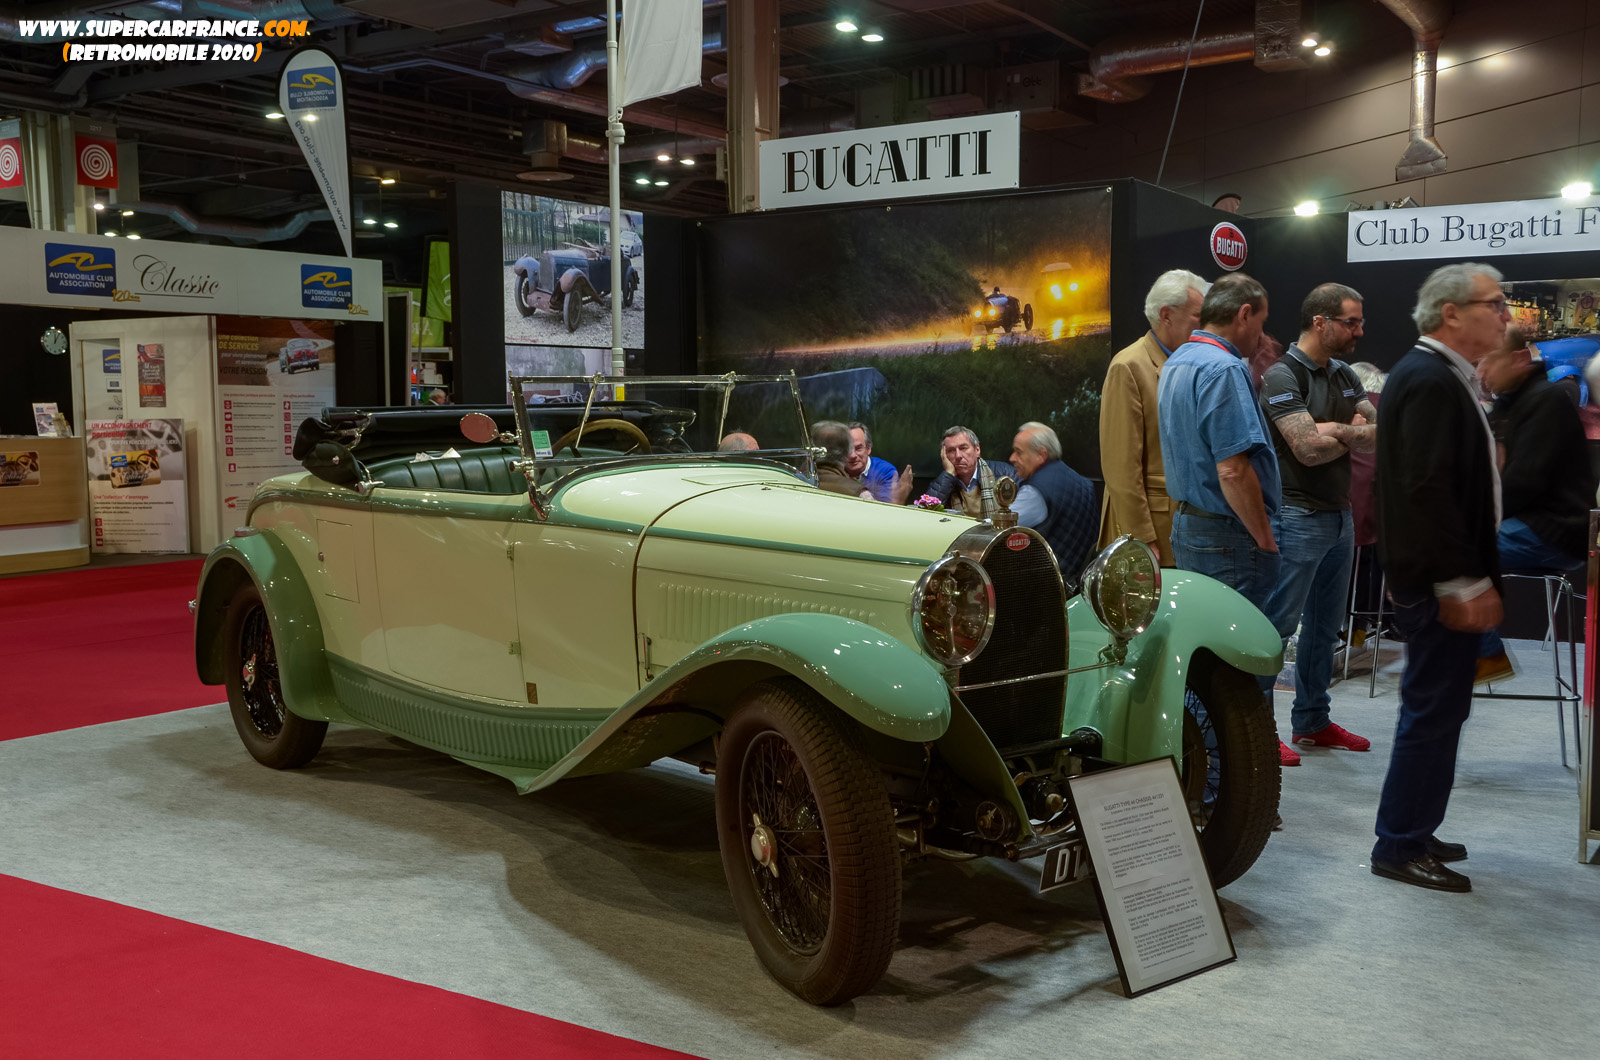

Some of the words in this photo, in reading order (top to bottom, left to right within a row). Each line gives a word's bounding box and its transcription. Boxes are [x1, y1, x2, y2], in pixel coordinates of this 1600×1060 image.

[781, 129, 992, 194] BUGATTI
[1354, 218, 1430, 246] Club
[1440, 209, 1563, 248] Bugatti
[1216, 236, 1244, 260] BUGATTI
[49, 272, 95, 282] AUTOMOBILE
[96, 274, 114, 282] CLUB
[132, 254, 222, 296] Classic
[59, 280, 106, 288] ASSOCIATION
[228, 342, 259, 351] SERVICES
[1009, 538, 1029, 547] BUGATTI
